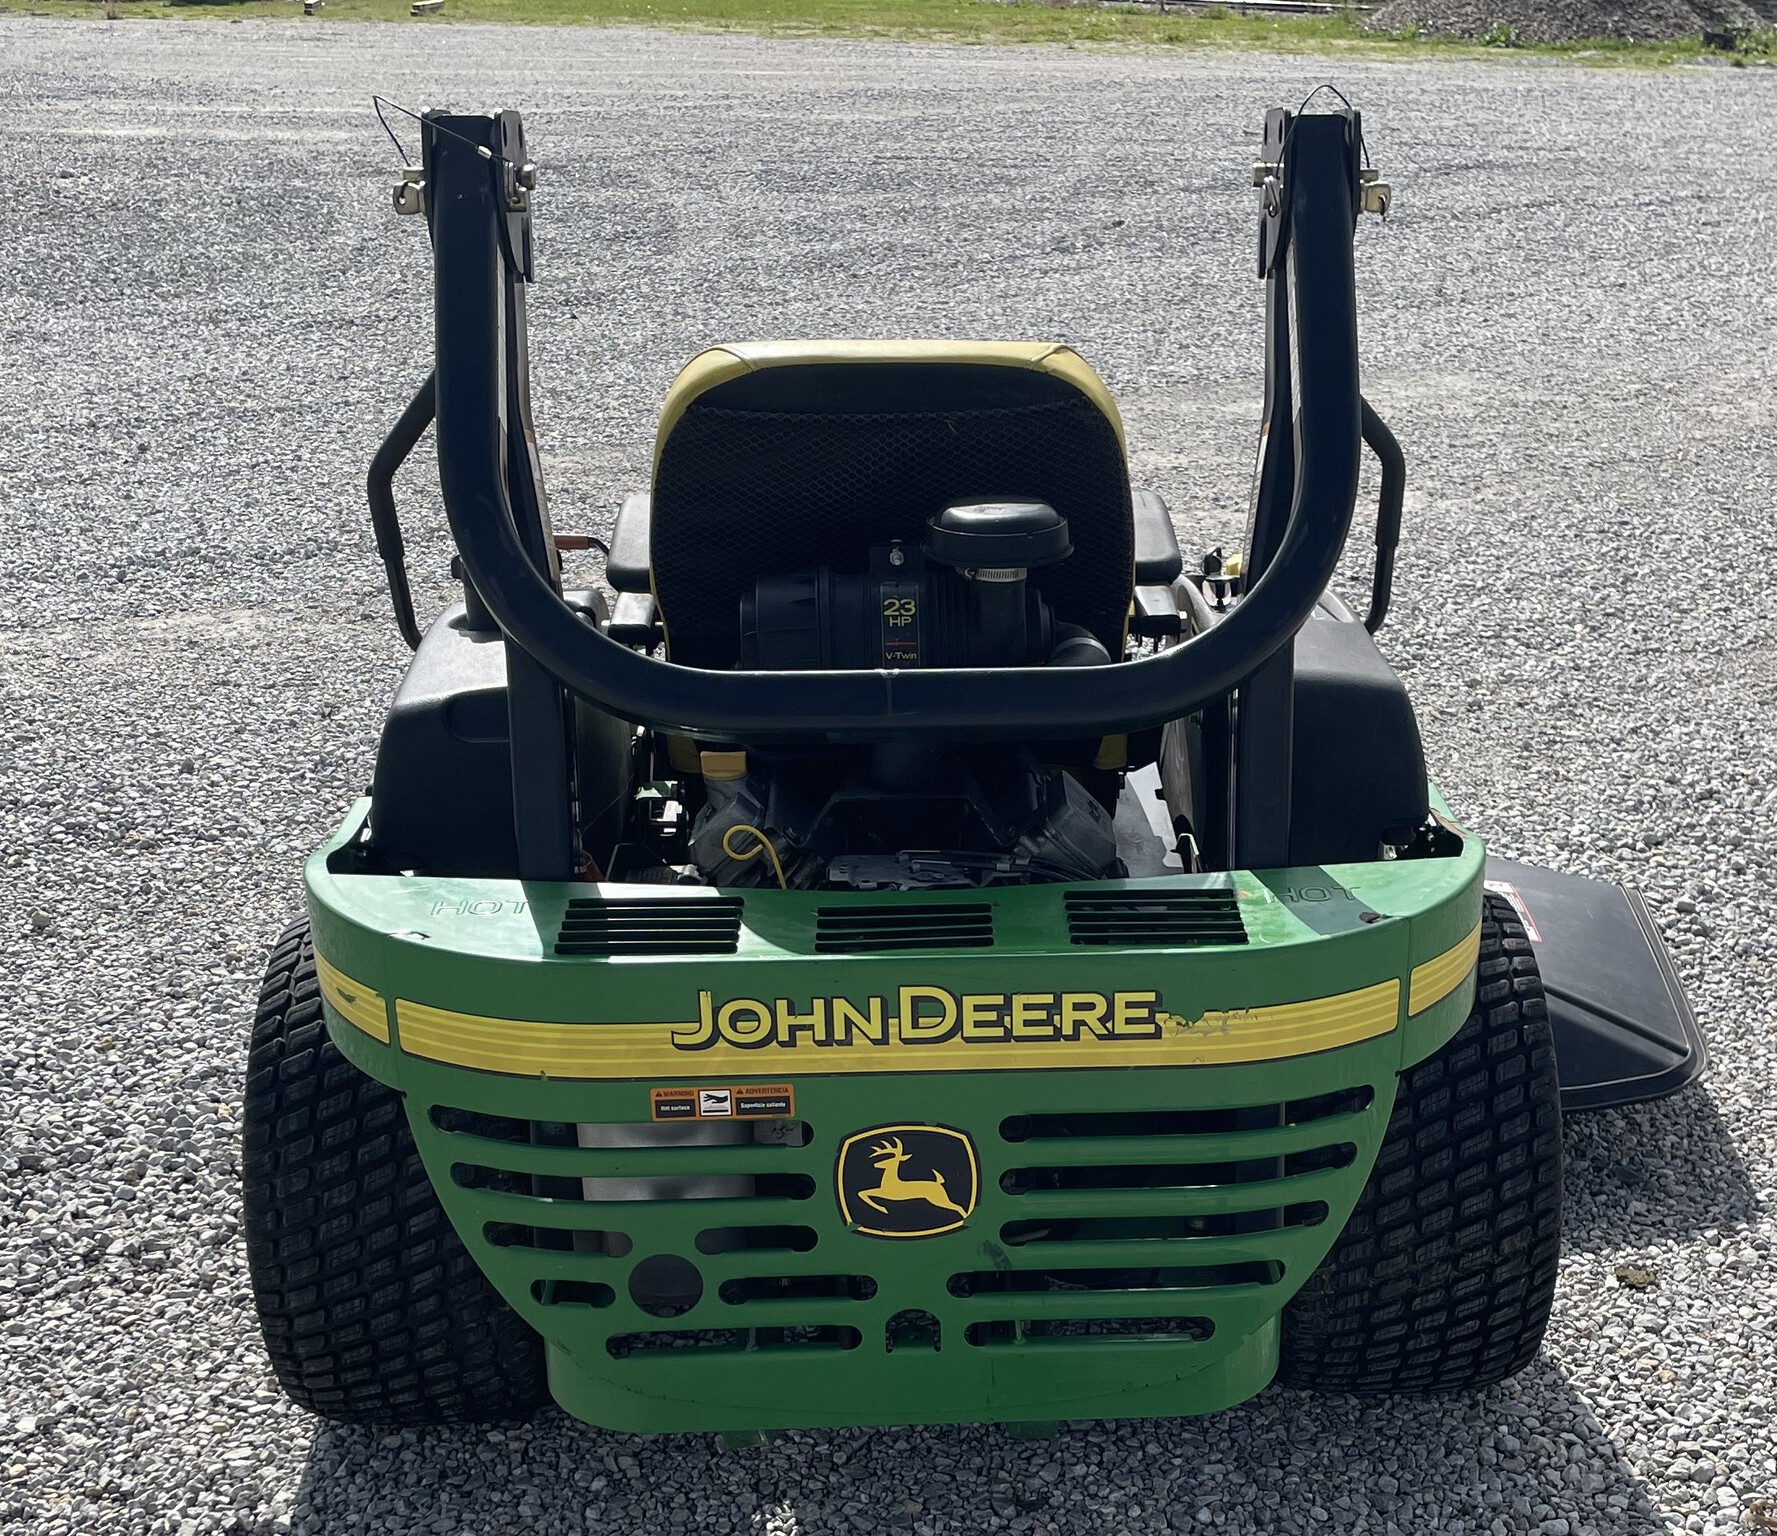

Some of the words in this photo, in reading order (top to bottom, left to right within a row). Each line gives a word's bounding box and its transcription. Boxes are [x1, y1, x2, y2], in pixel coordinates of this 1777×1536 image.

[883, 598, 917, 616] 23
[889, 616, 912, 627] HP
[885, 651, 917, 660] V-Twin
[1263, 886, 1361, 904] HOT
[430, 899, 529, 917] HOT
[671, 989, 890, 1051] JOHN
[899, 985, 1163, 1046] DEERE
[746, 1087, 789, 1095] ADVERTENCIA
